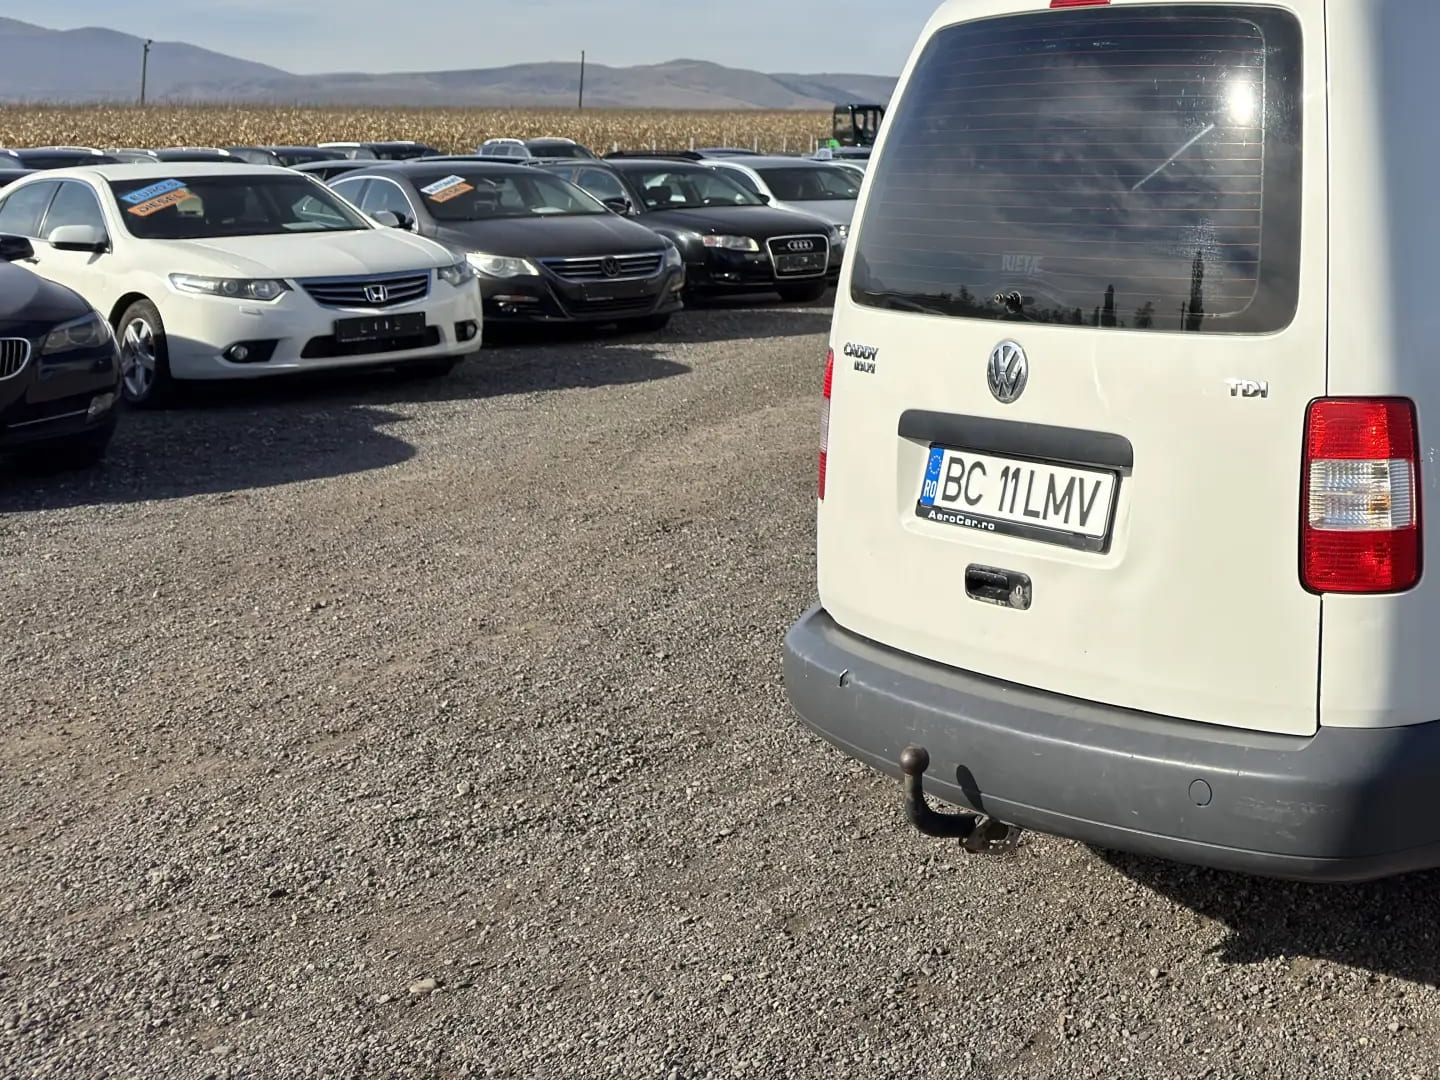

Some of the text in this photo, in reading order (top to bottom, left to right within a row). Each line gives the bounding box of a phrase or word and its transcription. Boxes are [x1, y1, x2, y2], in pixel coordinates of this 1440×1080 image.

[844, 342, 879, 361] CADDY
[1225, 379, 1269, 399] TDI
[923, 479, 936, 498] RO
[941, 456, 987, 506] BC
[927, 510, 995, 531] AeroCar.ro
